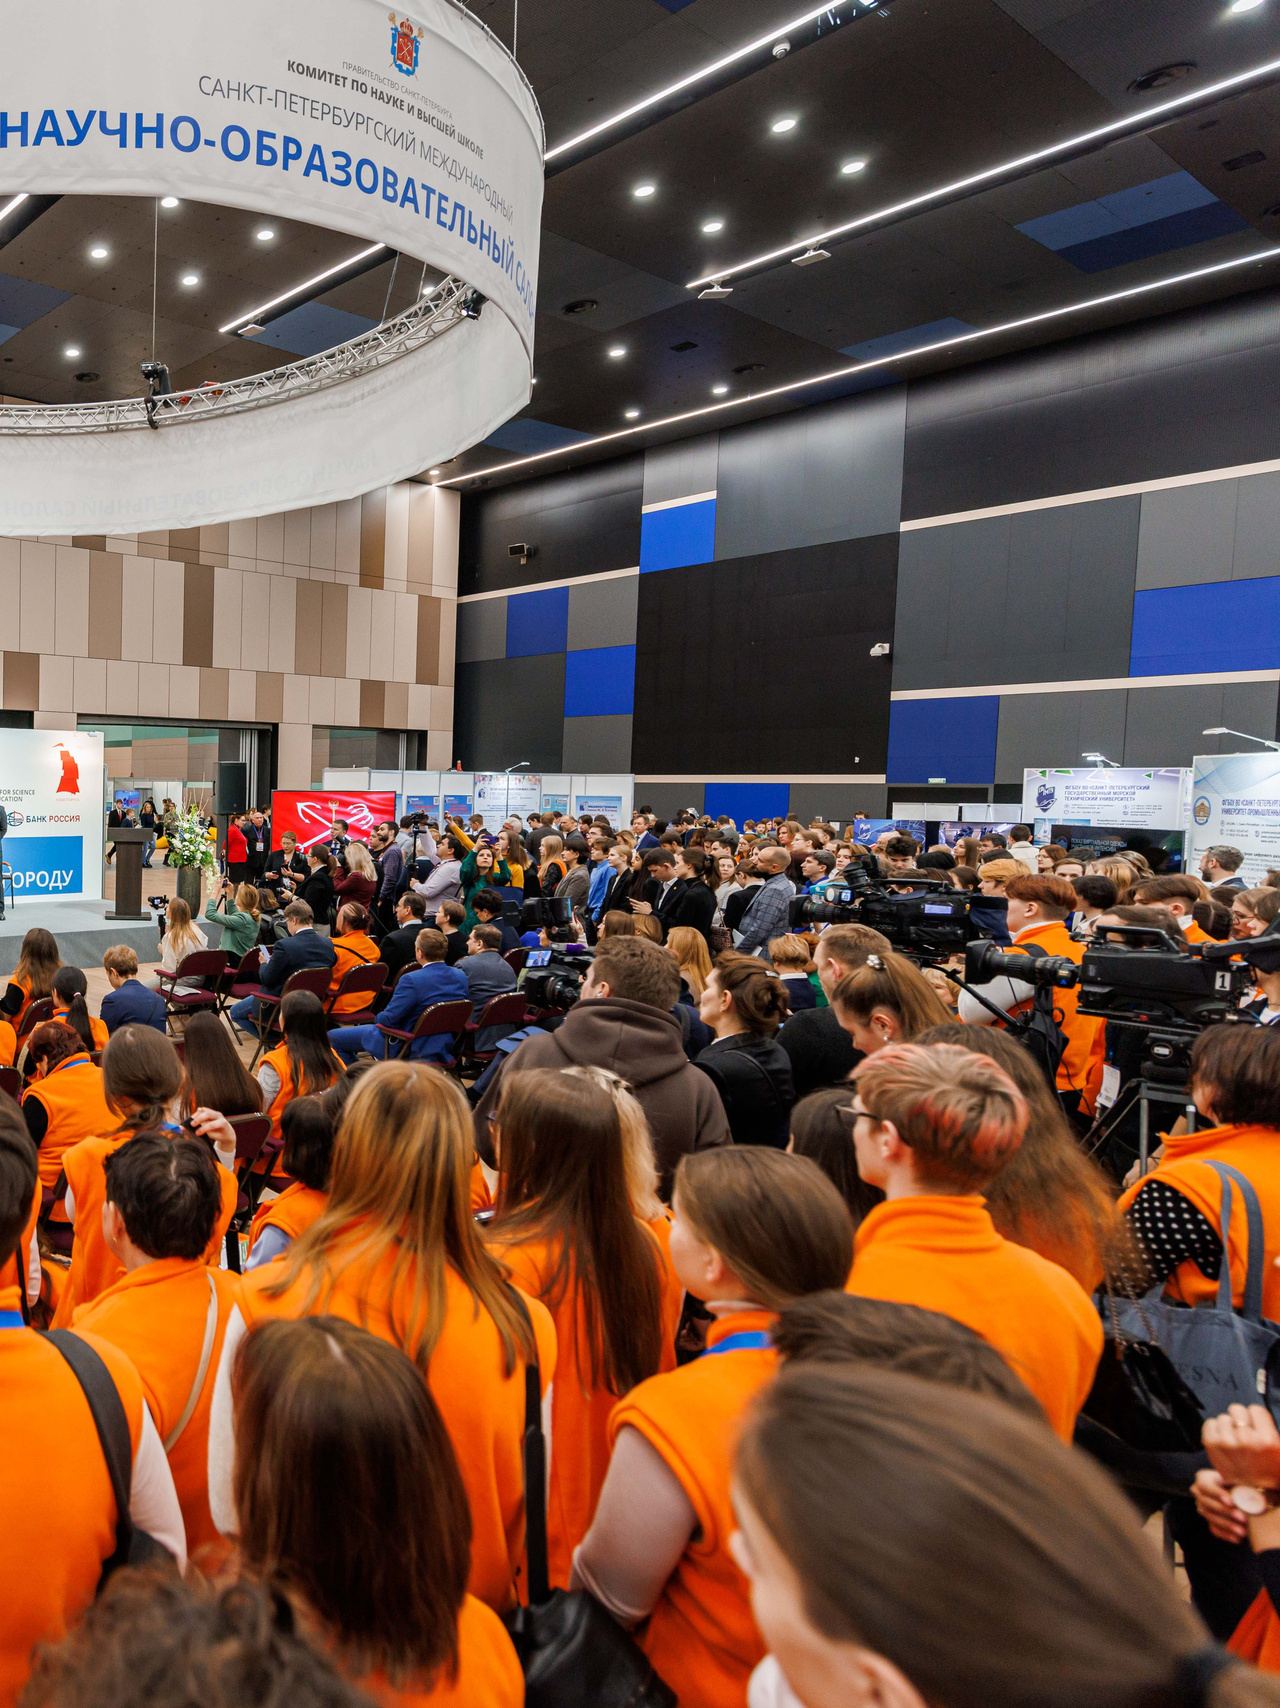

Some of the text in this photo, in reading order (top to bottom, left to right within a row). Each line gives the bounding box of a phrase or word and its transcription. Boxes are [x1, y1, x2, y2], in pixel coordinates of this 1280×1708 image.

[287, 59, 484, 160] КОМИТЕТ ПО НАУКЕ И ВЫСШЕЙ ШКОЛЕ
[342, 61, 453, 120] ПРАВИТЕЛЬСТВО САНКТ-ПЕТЕРБУРГА
[198, 75, 514, 226] САНКТ-ПЕТЕРБУРГСКИЙ МЕЖДУНАРОДНЫЙ
[0, 109, 515, 281] НАУЧНО-ОБРАЗОВАТЕЛЬНЫЙ
[26, 814, 81, 823] БАНК РОССИЯ
[1218, 973, 1227, 989] 1
